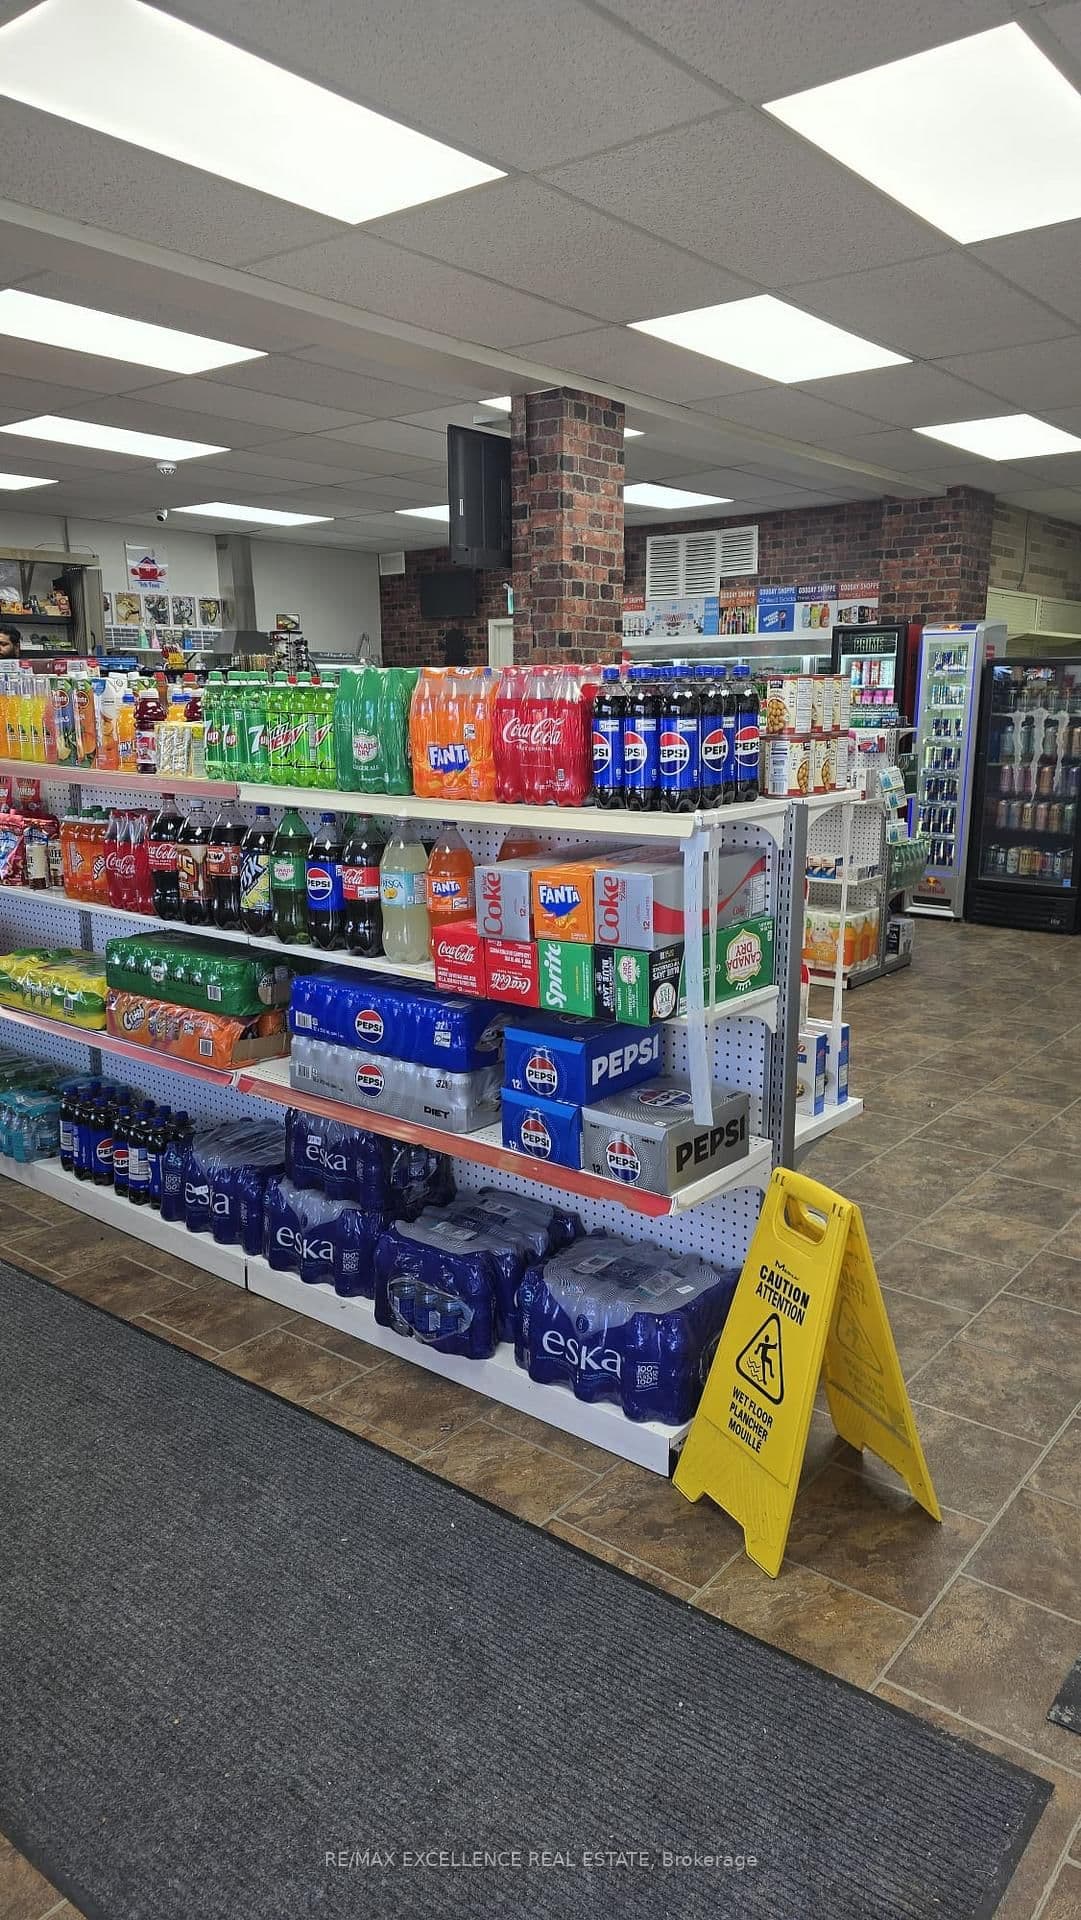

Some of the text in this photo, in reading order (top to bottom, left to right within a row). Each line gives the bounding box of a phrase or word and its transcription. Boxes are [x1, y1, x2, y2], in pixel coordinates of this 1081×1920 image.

[854, 637, 884, 652] PRIME
[503, 717, 565, 745] Coca-Cola
[428, 743, 470, 767] FANTA
[594, 745, 609, 757] PSI
[625, 746, 645, 757] EPSI
[661, 748, 687, 758] EPSI
[432, 882, 461, 893] FANTA
[538, 886, 580, 905] FANTA
[483, 872, 504, 936] Coke
[598, 876, 620, 945] Coke
[438, 941, 476, 961] Coca-Cola
[727, 950, 762, 971] CANADA
[735, 941, 753, 957] DRY
[491, 972, 532, 995] Coca-Cola
[544, 943, 567, 1009] Sprite
[123, 1003, 146, 1032] Crush
[356, 1020, 382, 1033] PEPSI
[591, 1033, 660, 1086] PEPSI
[357, 1075, 383, 1087] PEPSI
[527, 1069, 556, 1083] PEPSI
[423, 1105, 450, 1119] DIET
[522, 1132, 550, 1145] PEPSI
[675, 1114, 746, 1173] PEPSI
[305, 1145, 348, 1171] eska
[608, 1154, 639, 1170] PEPSI
[276, 1226, 334, 1263] eska
[760, 1264, 810, 1309] CAUTION
[755, 1281, 805, 1327] ATTENTION
[542, 1330, 622, 1379] eska
[732, 1385, 774, 1429] WET FLOOR
[729, 1401, 768, 1442] PLANCHER
[728, 1417, 762, 1454] MOUILLÉ
